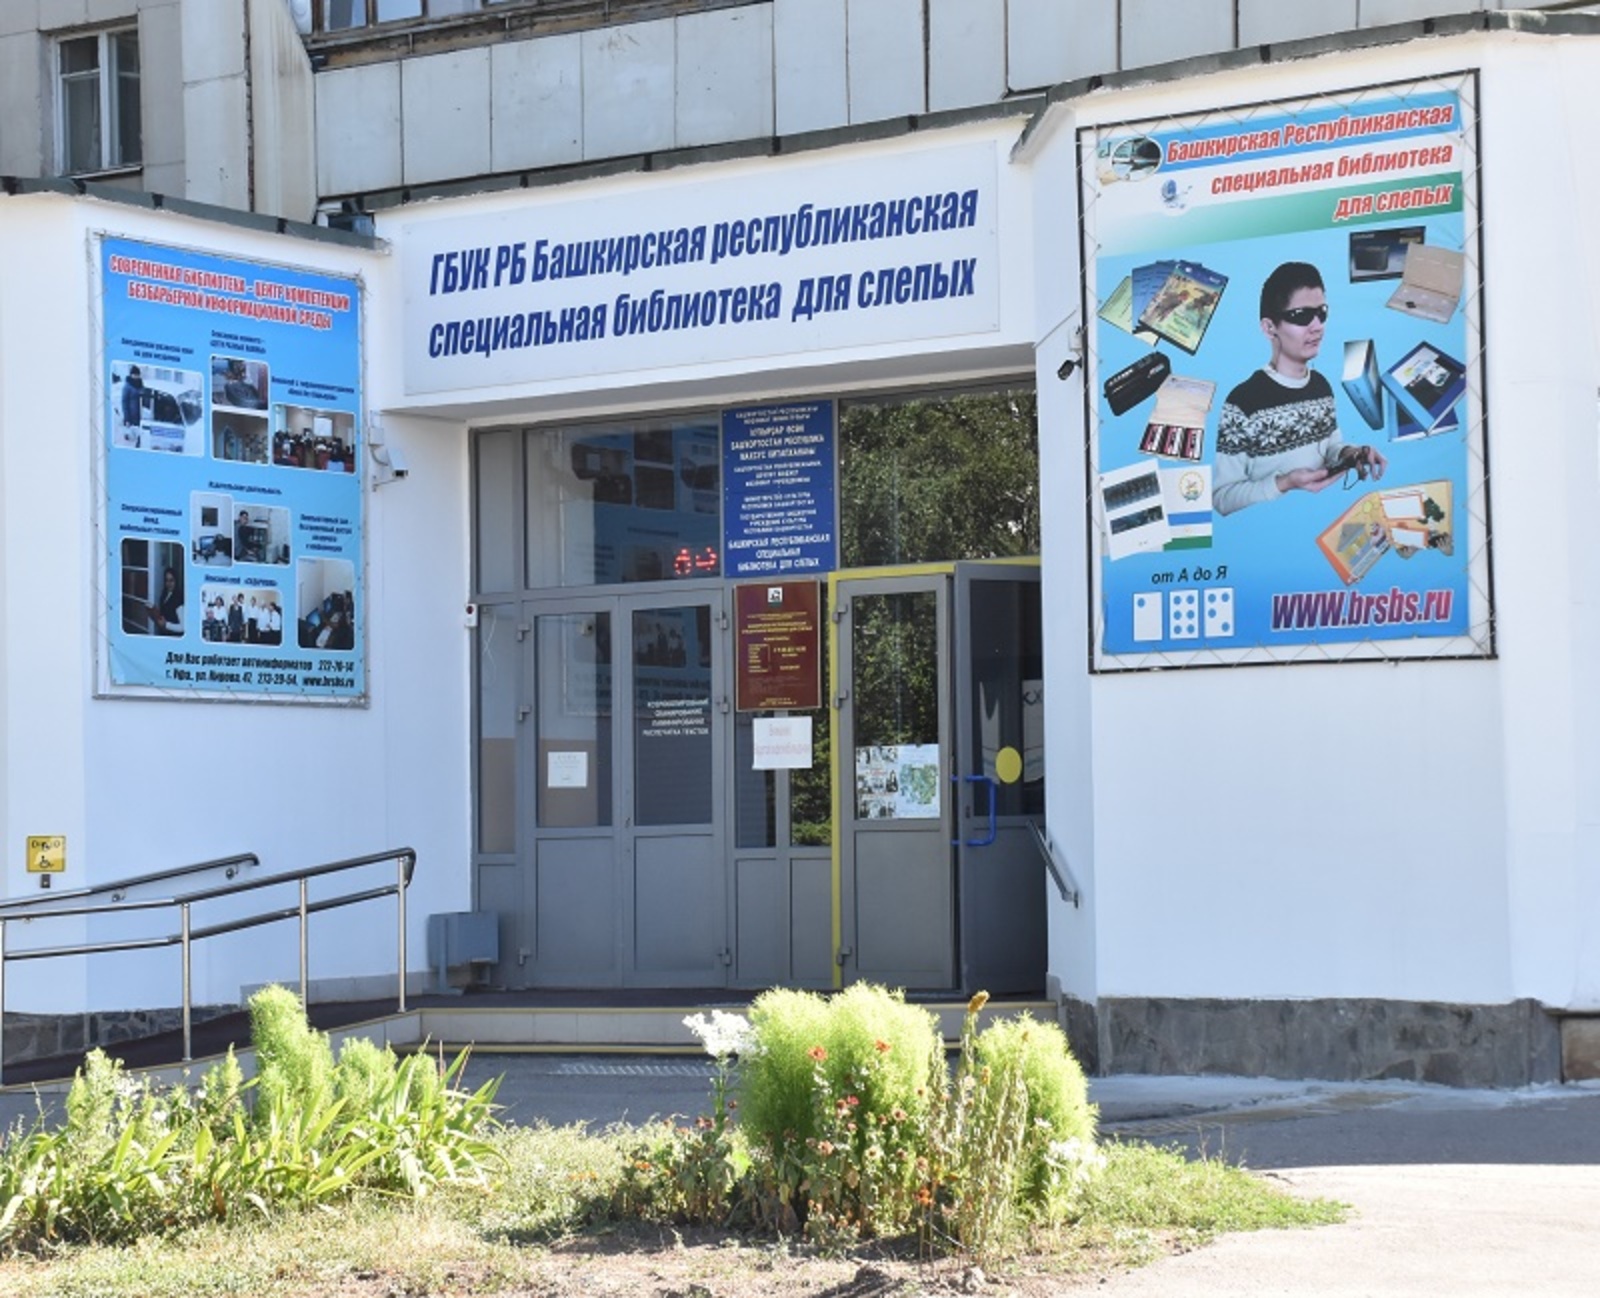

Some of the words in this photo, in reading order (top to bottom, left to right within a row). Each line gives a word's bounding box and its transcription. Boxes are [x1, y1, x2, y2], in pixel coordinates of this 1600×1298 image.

[1166, 126, 1281, 164] Башкирская
[1283, 105, 1453, 147] Республиканская
[1211, 160, 1334, 196] специальная
[1337, 145, 1453, 179] библиотека
[1332, 194, 1374, 221] для
[1375, 185, 1452, 212] слепых
[429, 247, 491, 296] ГБУК
[493, 242, 526, 287] РБ
[532, 225, 707, 283] Башкирская
[710, 189, 979, 264] республиканская
[110, 255, 182, 282] СОВРЕМЕННАЯ
[183, 265, 245, 293] БИБЛИОТЕКА
[254, 279, 284, 300] ЦЕНТР
[128, 281, 204, 309] БЕЗБАРЬЕРНОЙ
[205, 294, 298, 325] ИНФОРМАЦИОННОЙ
[298, 308, 331, 330] СРЕДЫ
[429, 303, 608, 358] специальная
[613, 281, 782, 337] библиотека
[791, 273, 853, 323] для
[857, 258, 977, 309] слепых
[1151, 571, 1175, 585] от
[1177, 567, 1188, 583] А
[1193, 566, 1212, 581] до
[1215, 565, 1227, 580] Я
[165, 651, 184, 665] Для
[185, 652, 201, 665] Вас
[201, 653, 241, 667] работает
[241, 656, 313, 672] автоинформатор
